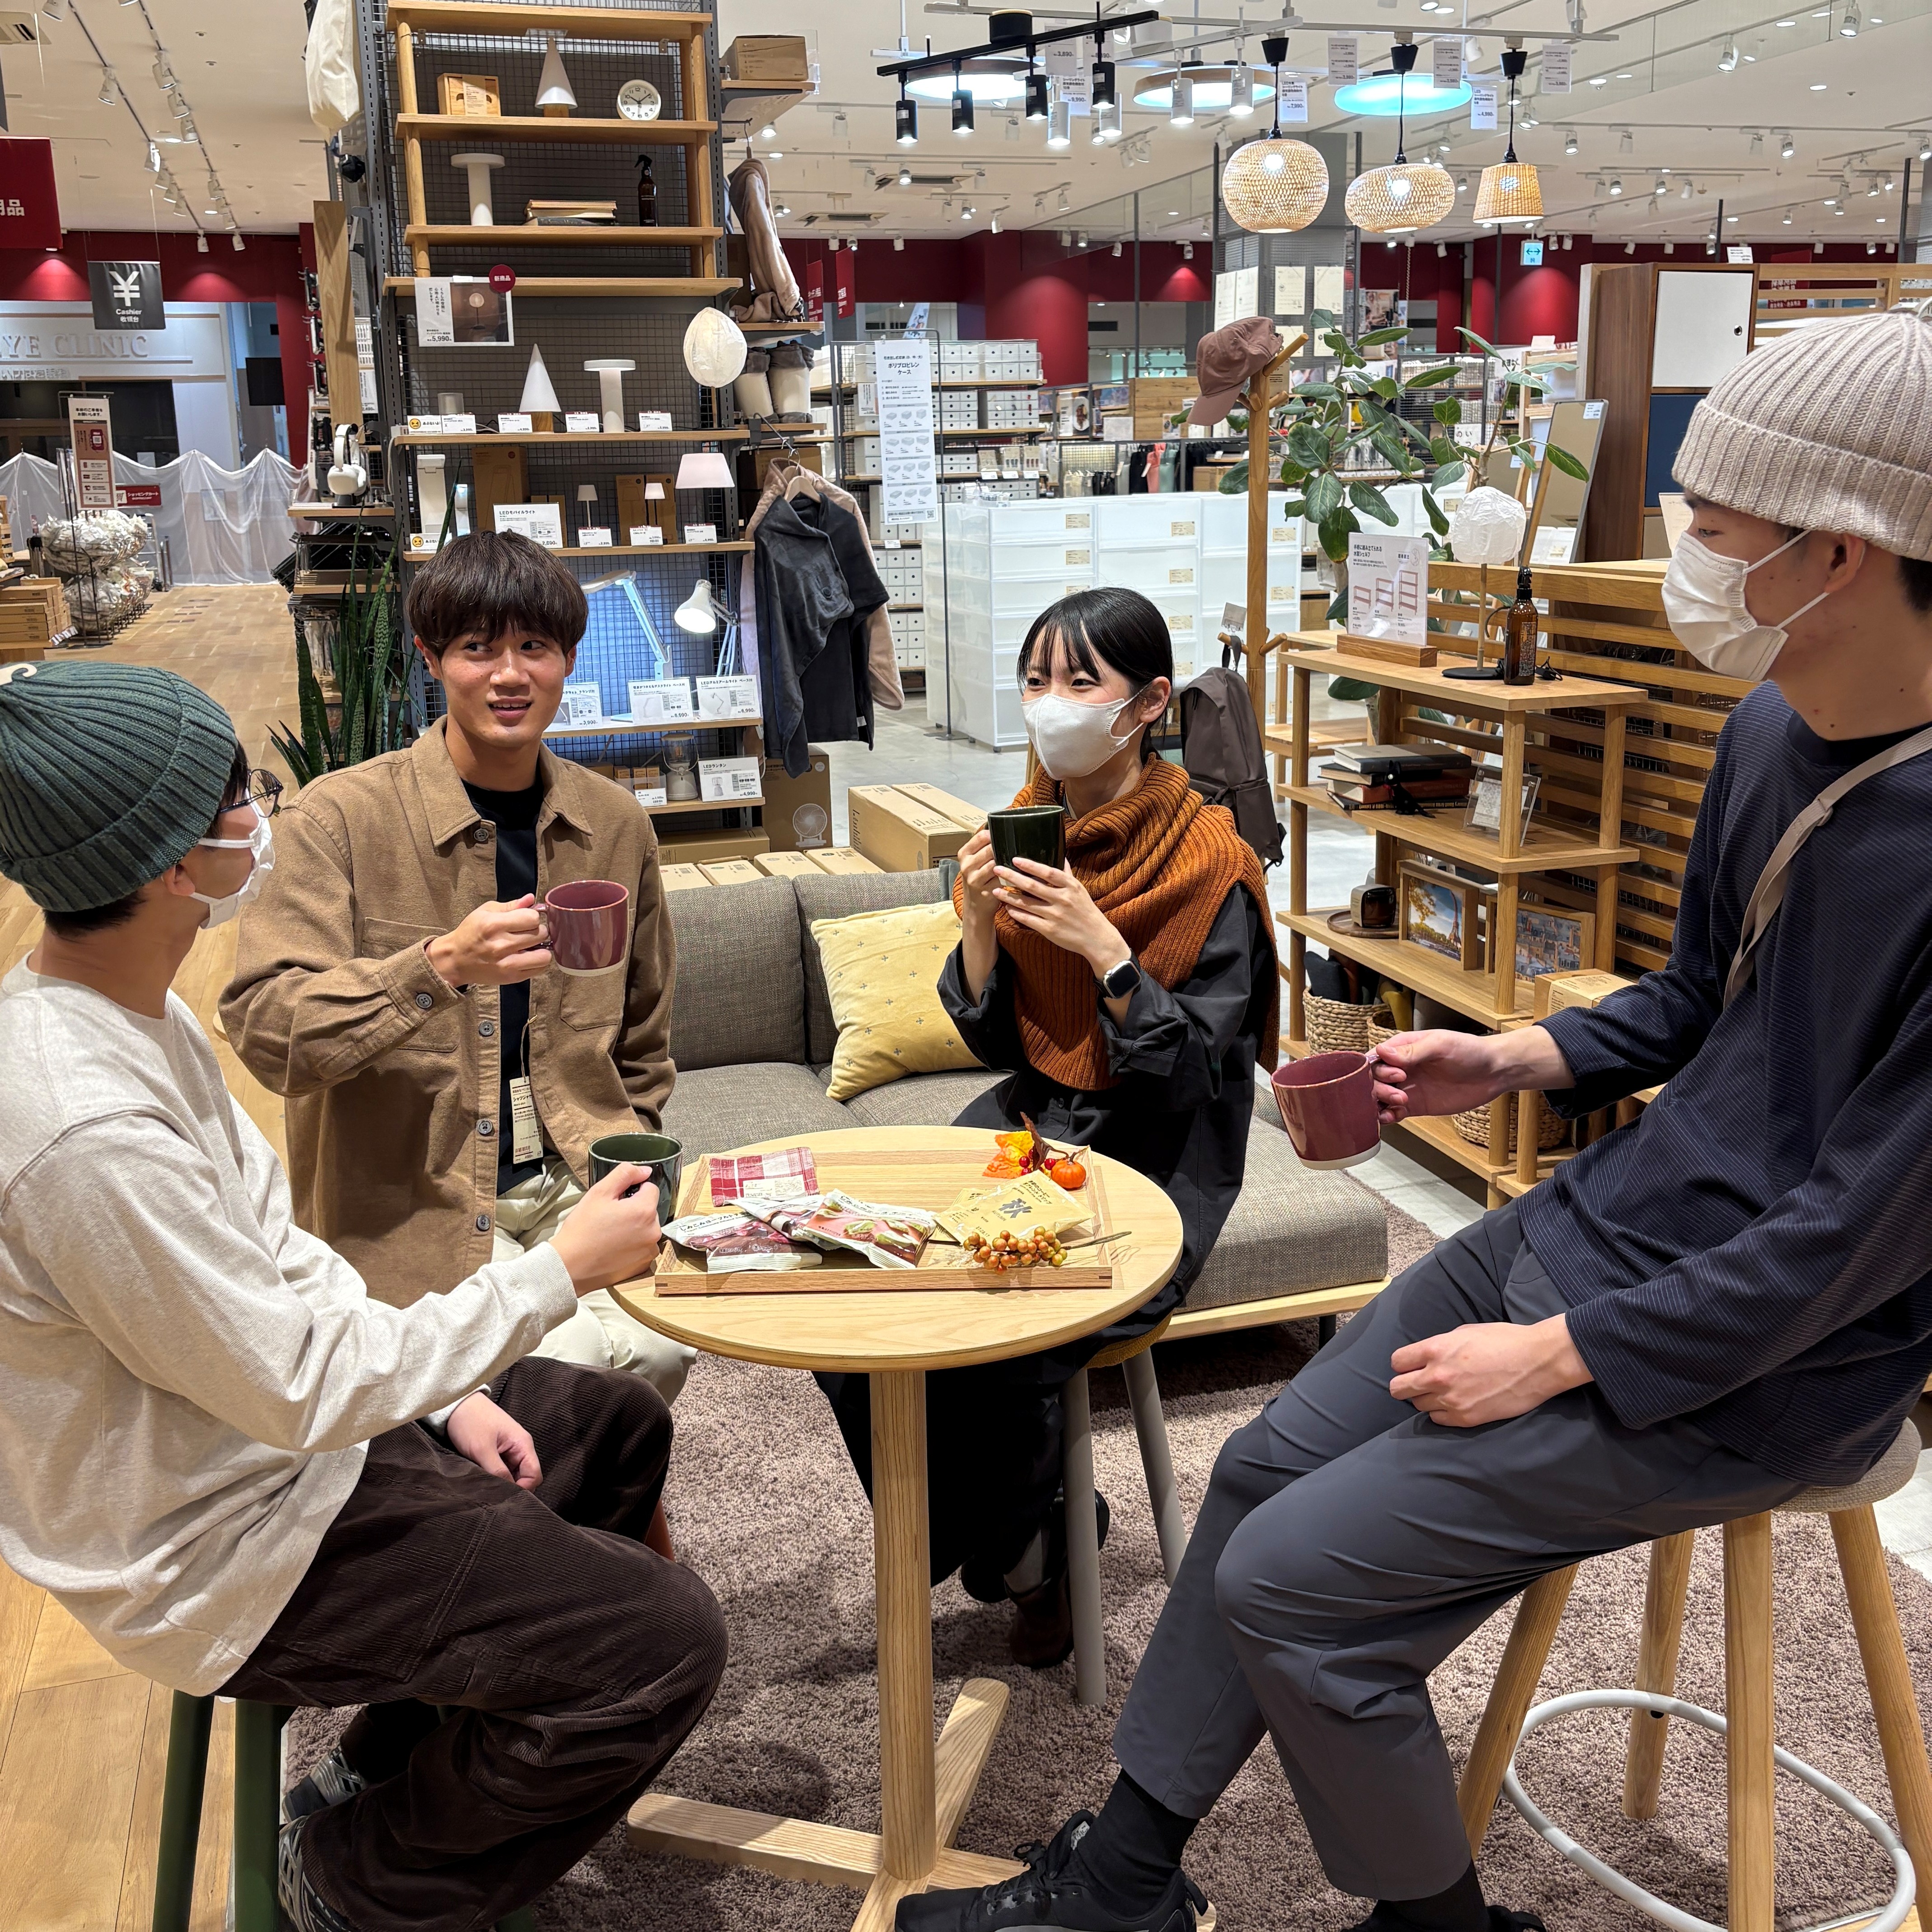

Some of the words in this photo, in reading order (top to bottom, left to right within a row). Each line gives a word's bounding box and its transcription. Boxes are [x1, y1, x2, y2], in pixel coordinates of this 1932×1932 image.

[0, 335, 42, 358] YE
[51, 333, 148, 358] CLINIC
[999, 1198, 1033, 1219] 秋
